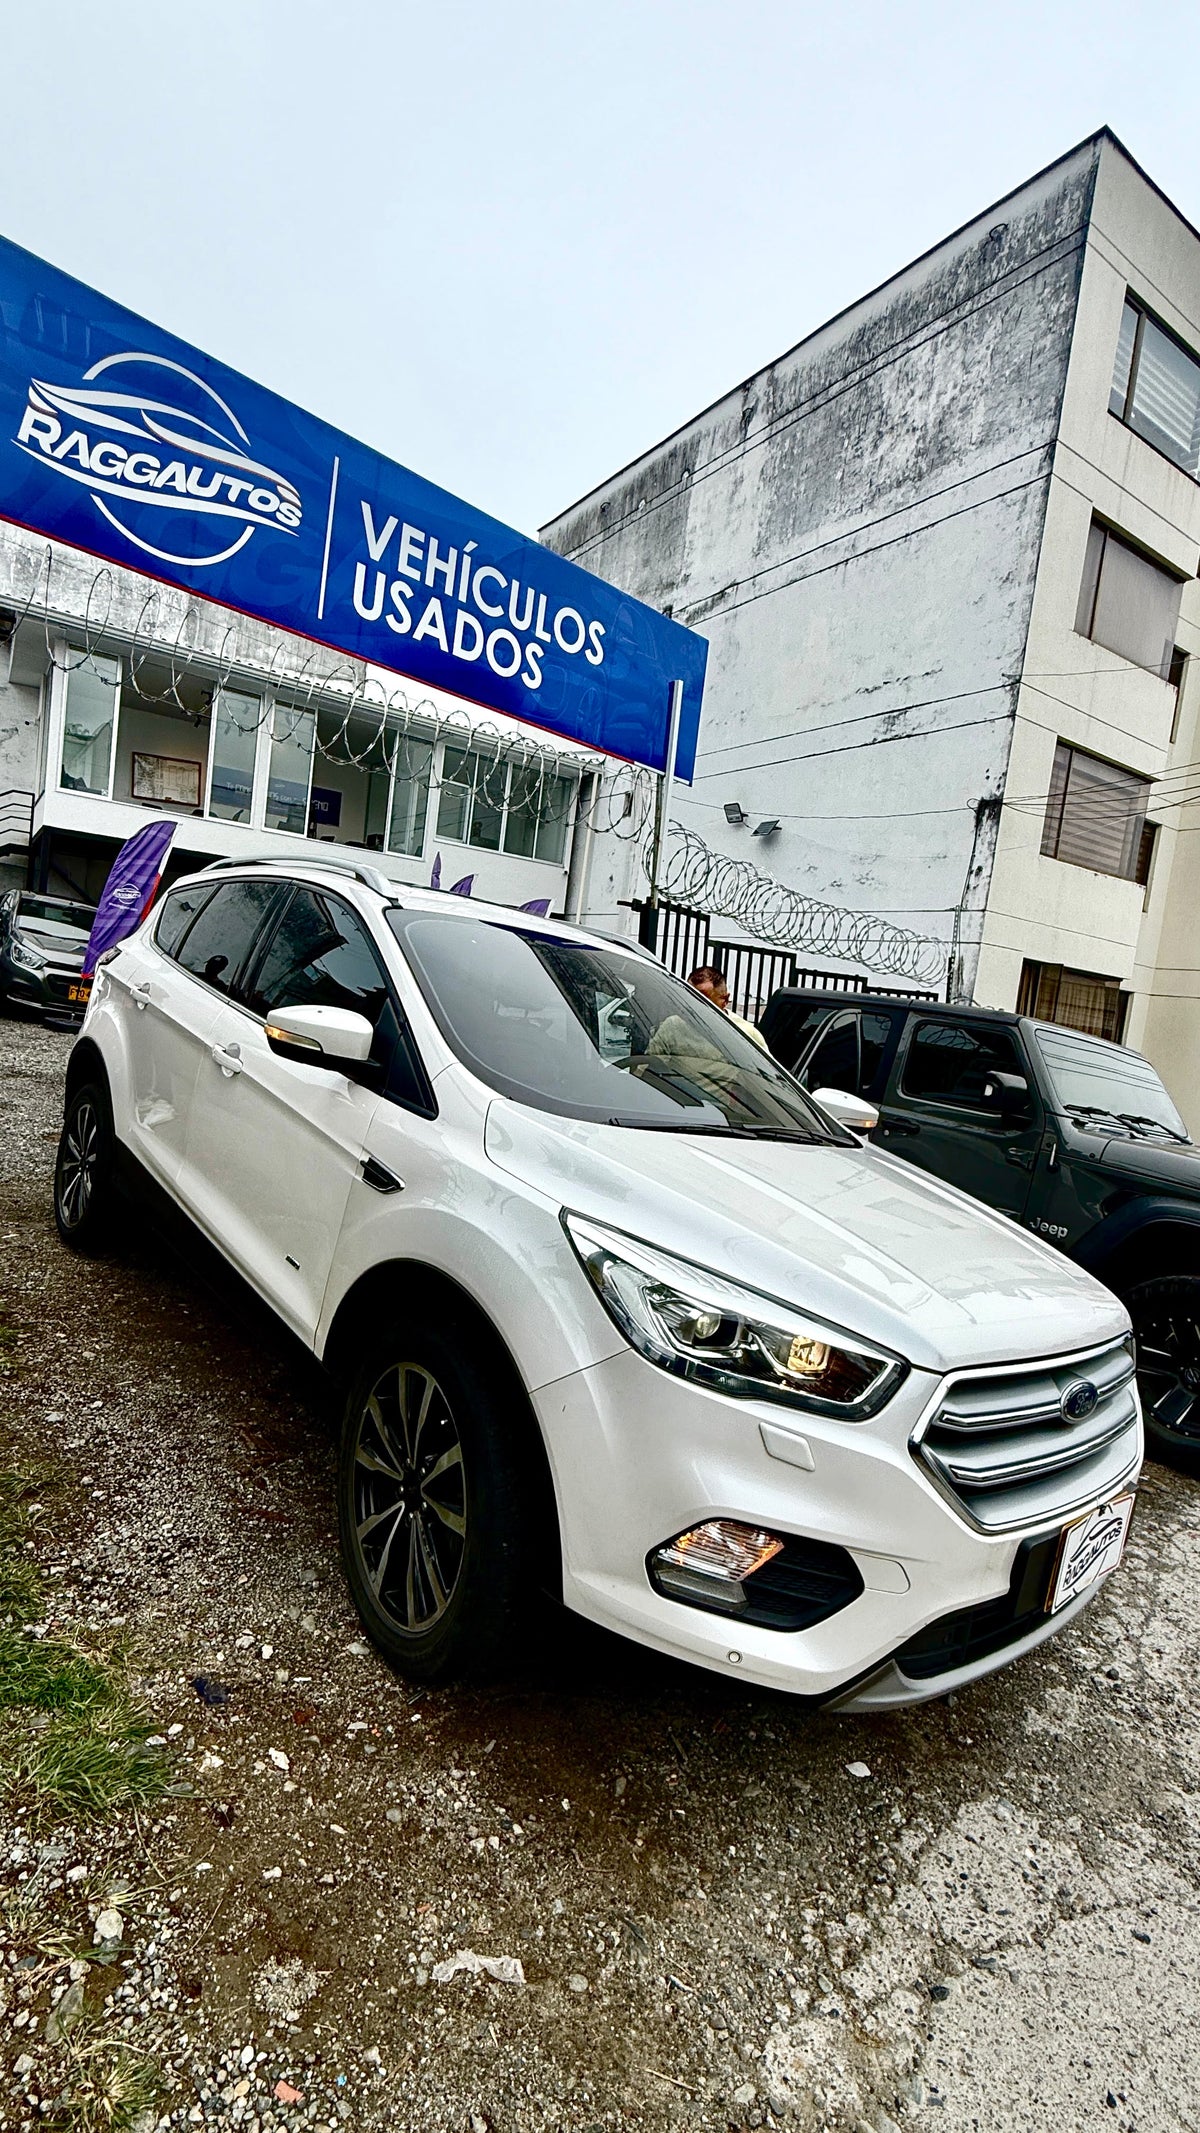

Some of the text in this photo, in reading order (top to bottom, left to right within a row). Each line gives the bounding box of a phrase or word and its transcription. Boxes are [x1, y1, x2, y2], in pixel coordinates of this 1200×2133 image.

[16, 403, 304, 528] RAGGAUTOS
[352, 561, 546, 690] USADOS
[360, 500, 607, 666] VEHÍCULOS
[1029, 1216, 1069, 1239] Jeep
[1062, 1525, 1123, 1588] RAGGAUTOS
